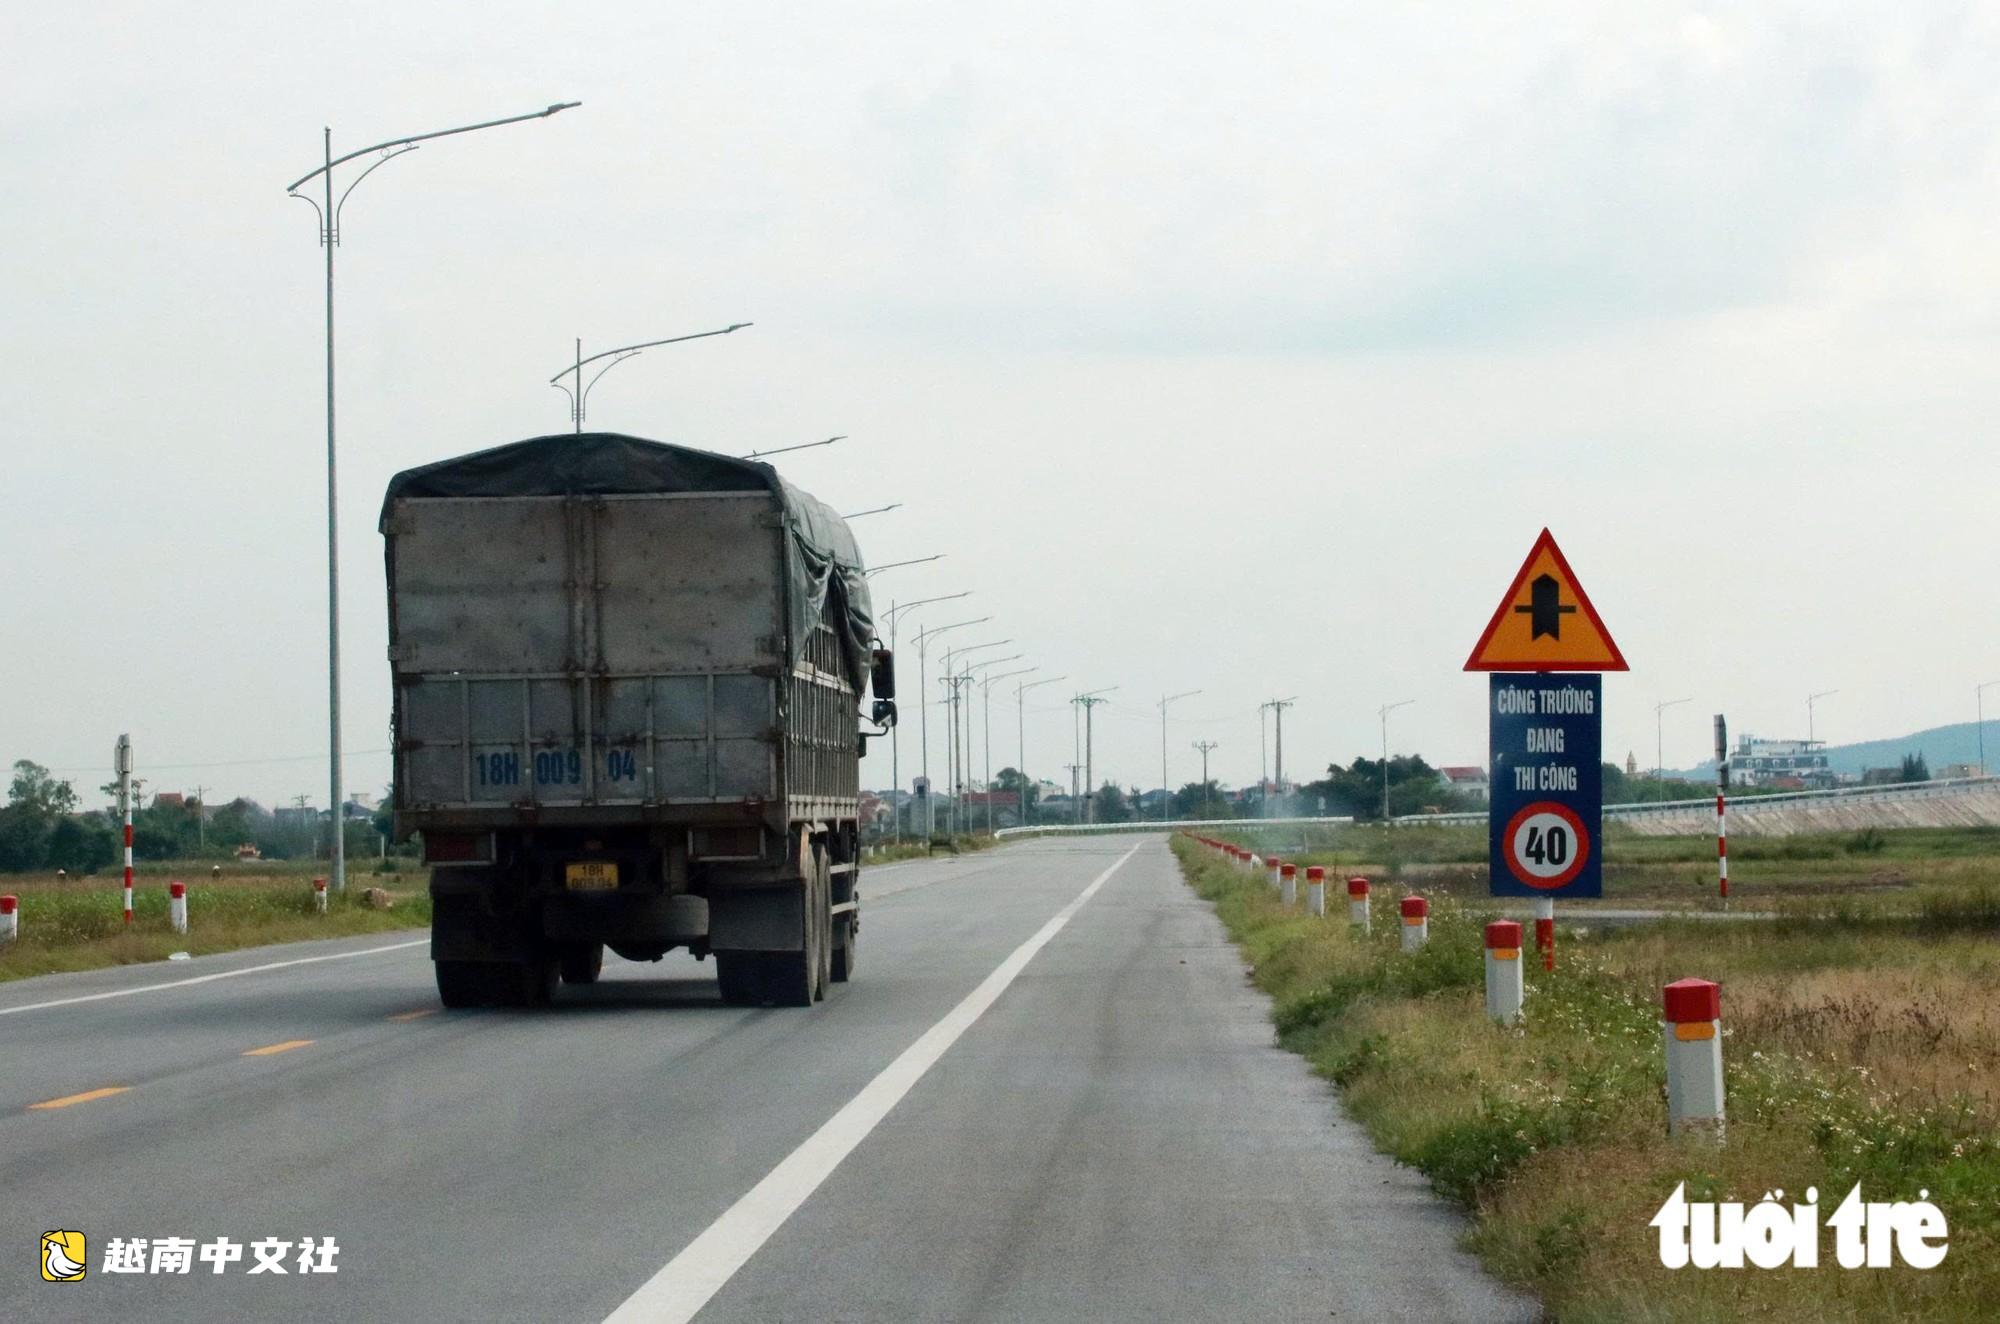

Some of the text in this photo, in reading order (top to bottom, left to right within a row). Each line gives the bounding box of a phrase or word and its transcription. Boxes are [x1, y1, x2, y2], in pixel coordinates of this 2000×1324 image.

[1497, 684, 1595, 715] CÔNG TRƯỜNG
[1526, 728, 1565, 753] ĐANG
[476, 752, 520, 785] 18H
[536, 751, 581, 785] 009
[1514, 762, 1577, 791] THI CÔNG
[1525, 826, 1566, 865] 40
